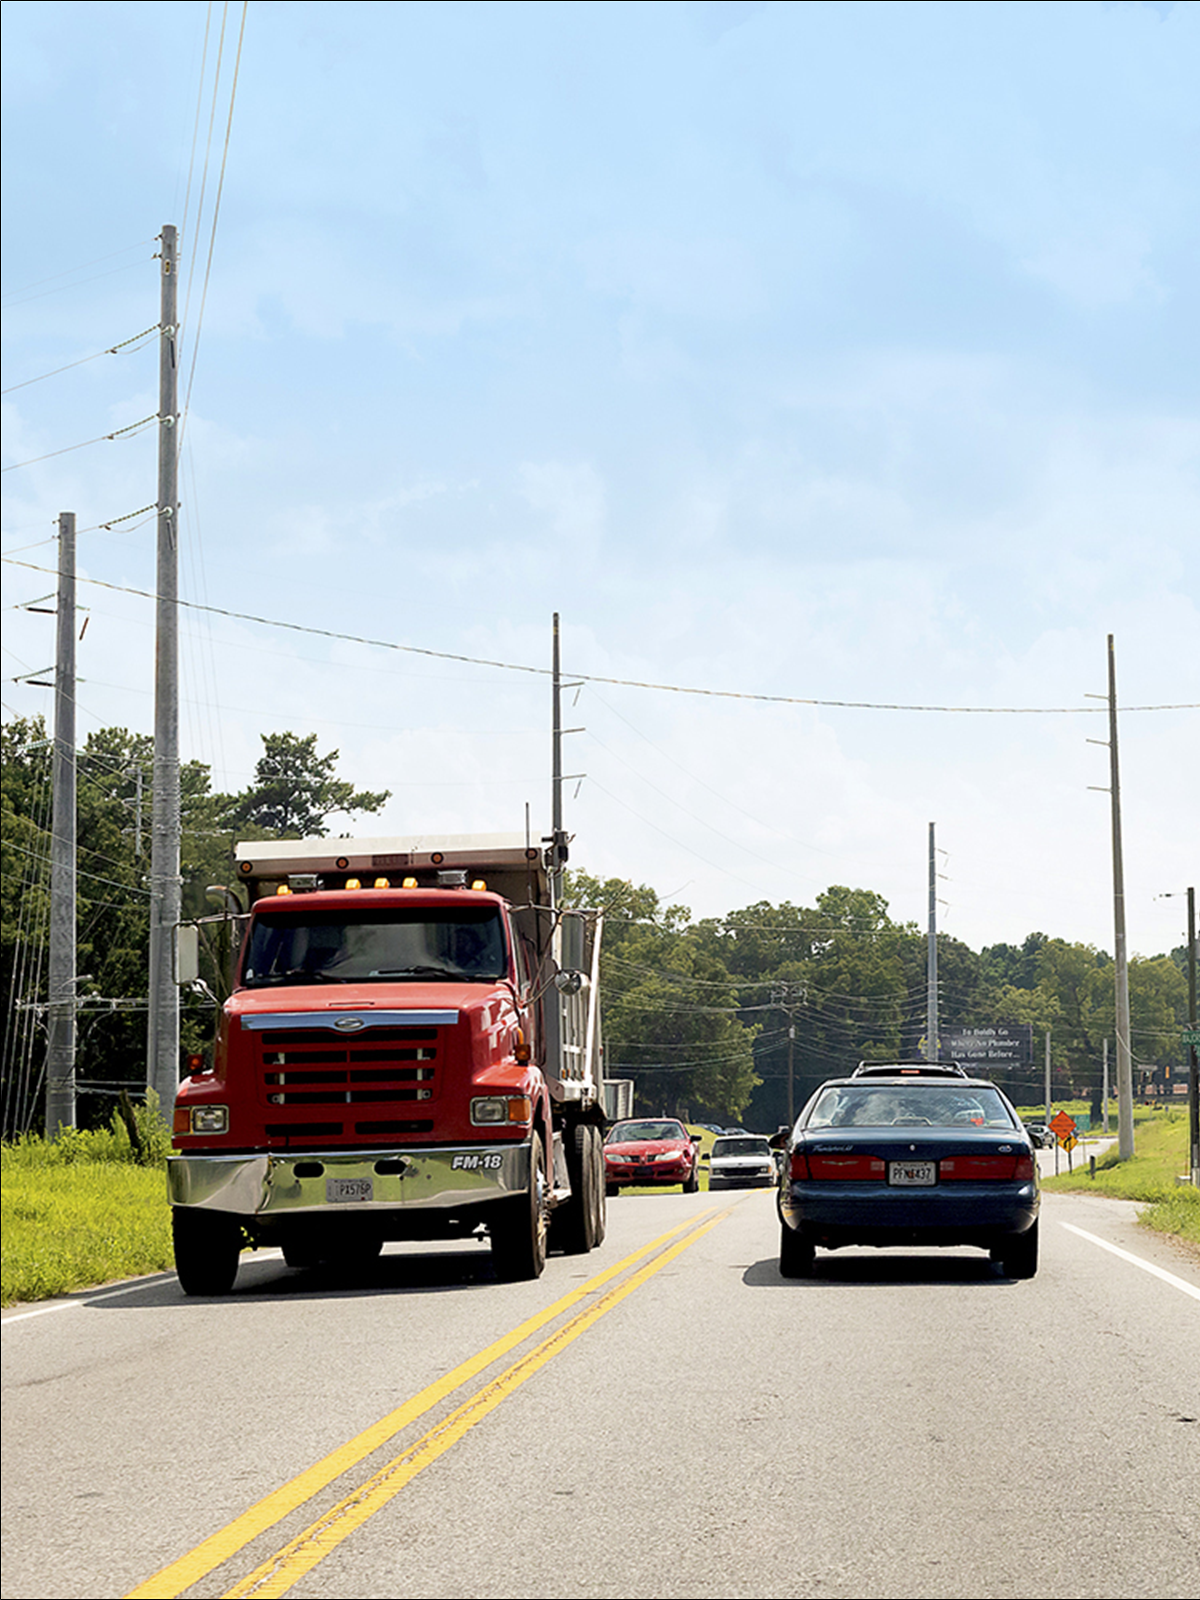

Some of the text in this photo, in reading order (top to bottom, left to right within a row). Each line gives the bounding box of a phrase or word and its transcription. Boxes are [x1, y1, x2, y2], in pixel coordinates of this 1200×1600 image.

[998, 1028, 1009, 1036] Go
[988, 1039, 1020, 1047] Plumber
[968, 1050, 987, 1059] Gone
[453, 1155, 502, 1169] FM-18
